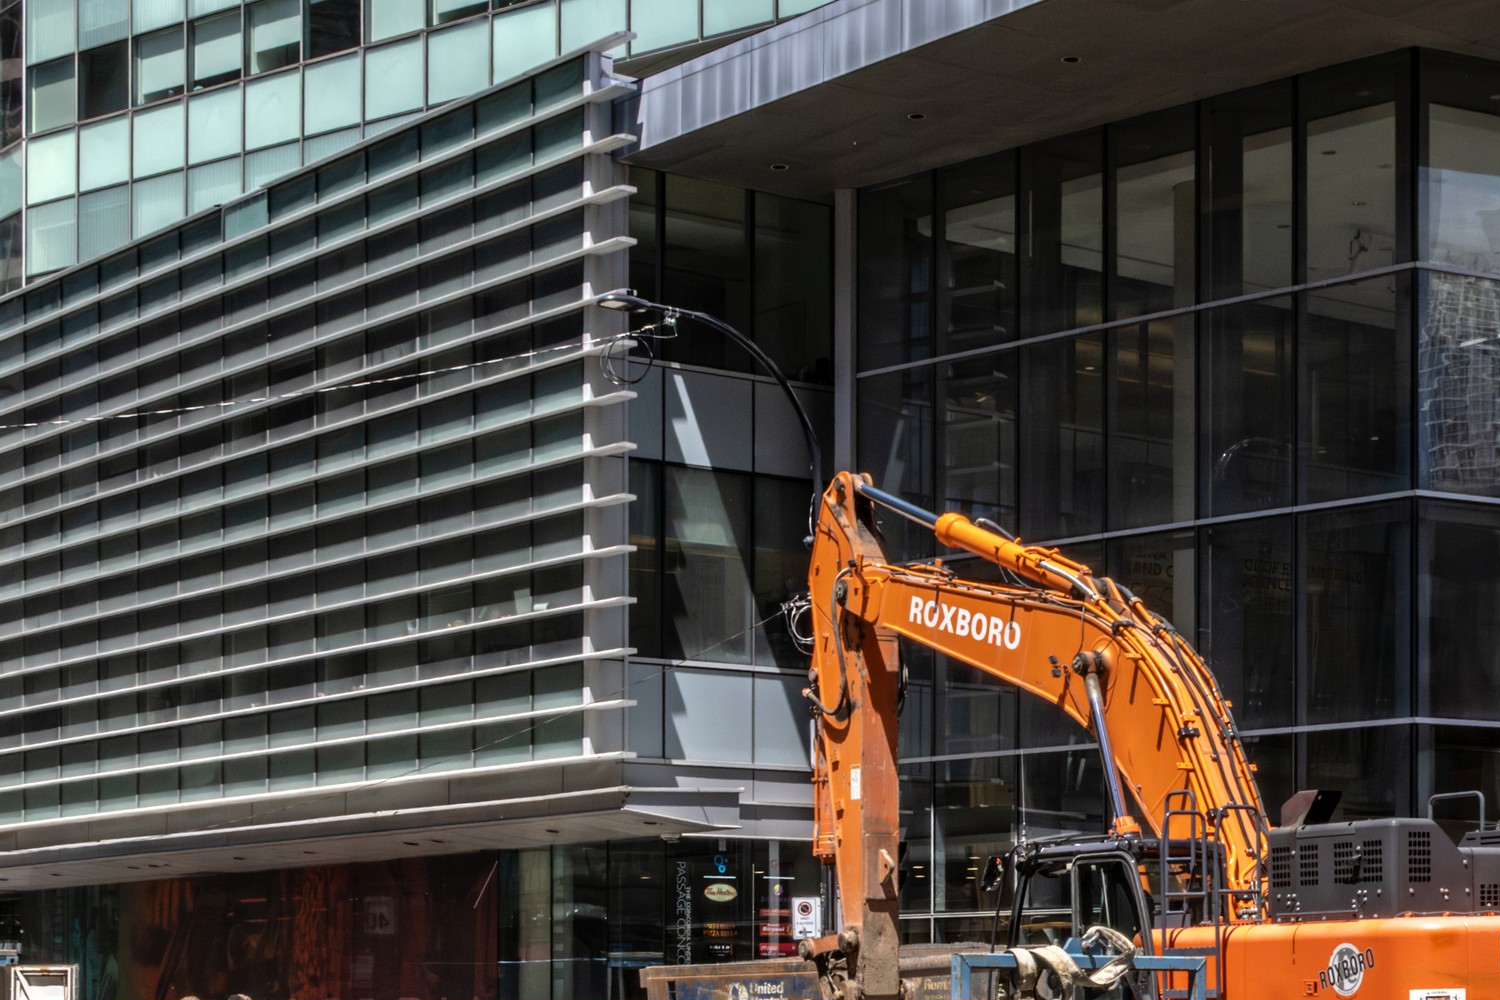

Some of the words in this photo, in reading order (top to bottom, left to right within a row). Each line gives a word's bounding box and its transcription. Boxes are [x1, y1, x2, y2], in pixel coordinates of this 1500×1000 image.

[908, 595, 1022, 651] ROXBORO
[676, 861, 687, 915] PASSAGE
[749, 981, 785, 994] United
[1318, 946, 1376, 991] ROXBORO
